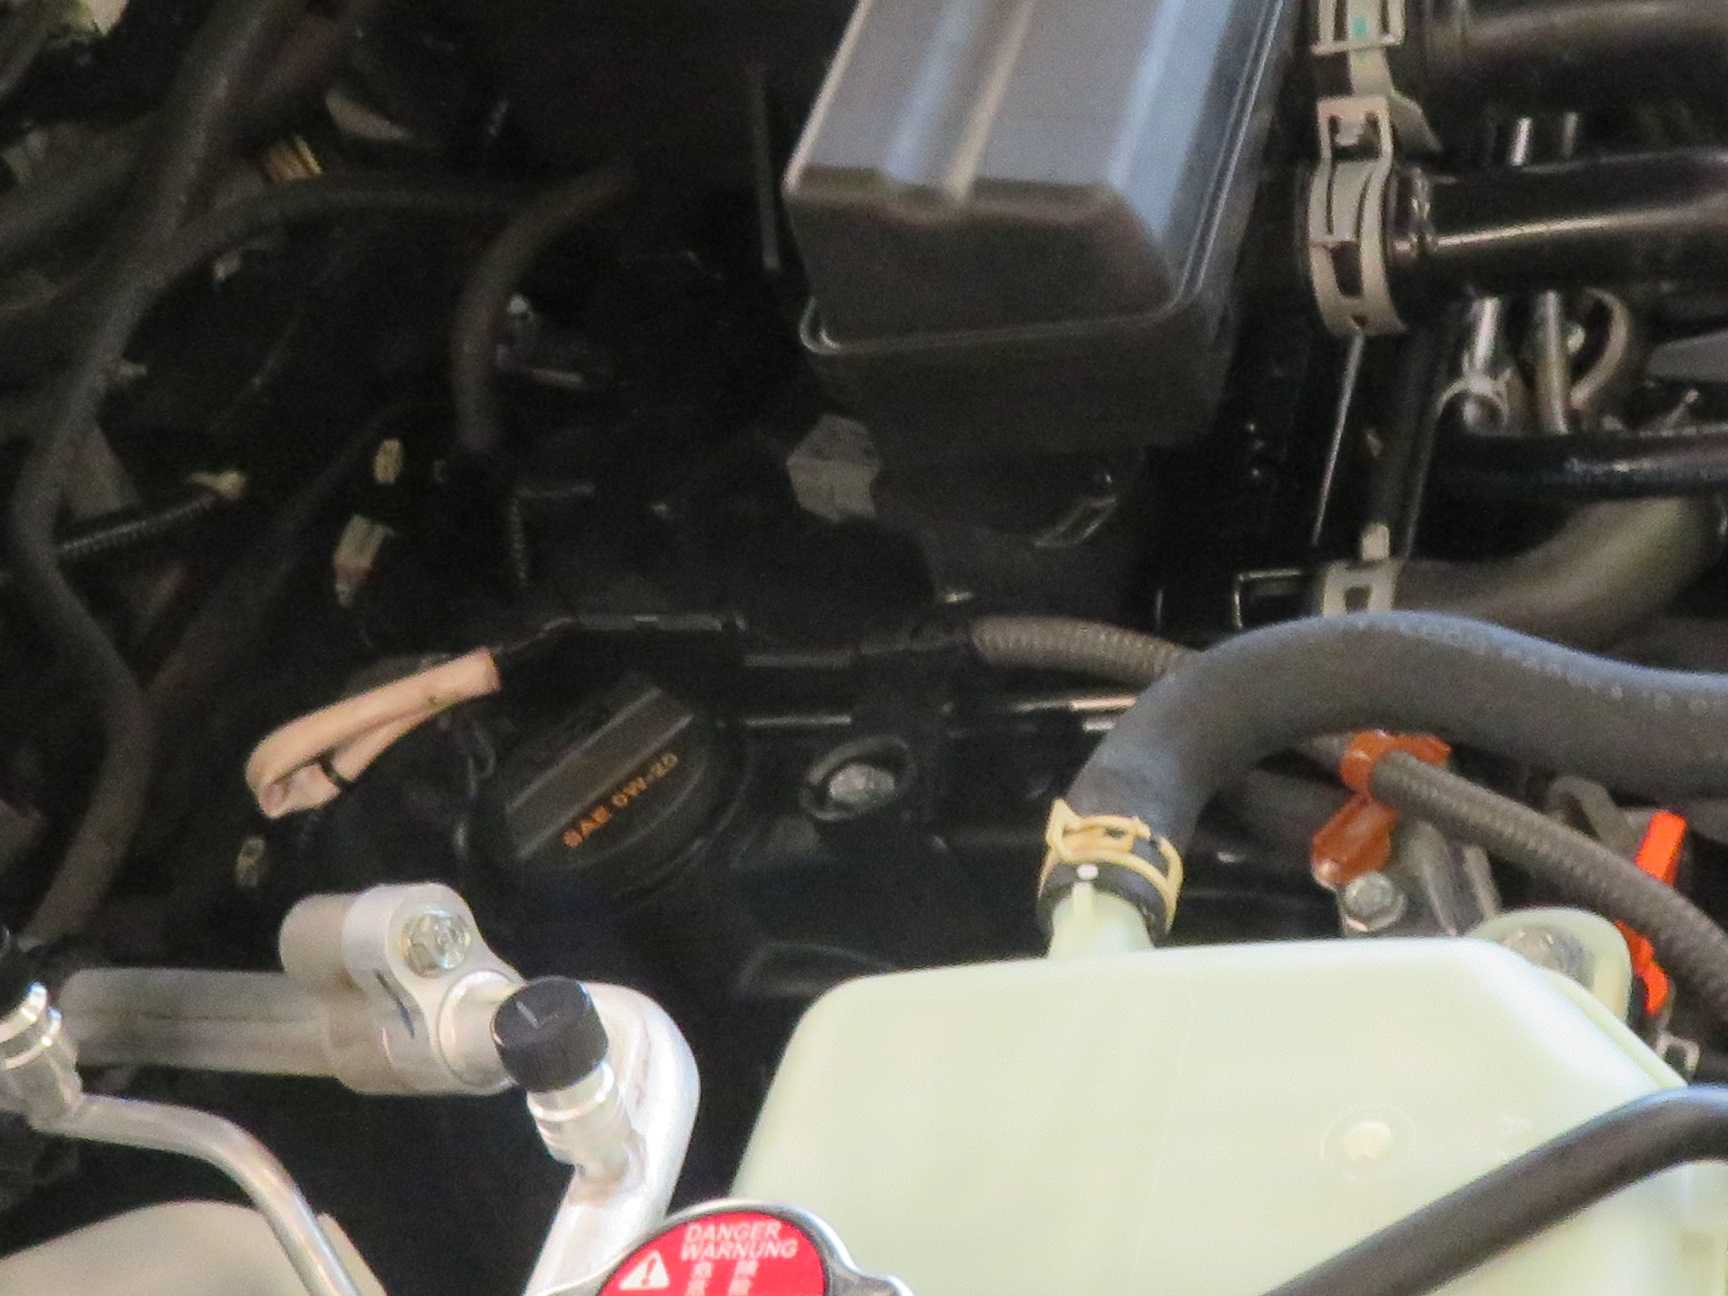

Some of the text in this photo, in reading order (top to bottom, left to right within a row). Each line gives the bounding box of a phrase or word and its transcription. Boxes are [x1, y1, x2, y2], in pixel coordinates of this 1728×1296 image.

[562, 805, 610, 848] SAE
[686, 1220, 782, 1242] DANGER
[680, 1237, 799, 1262] WARNUNG
